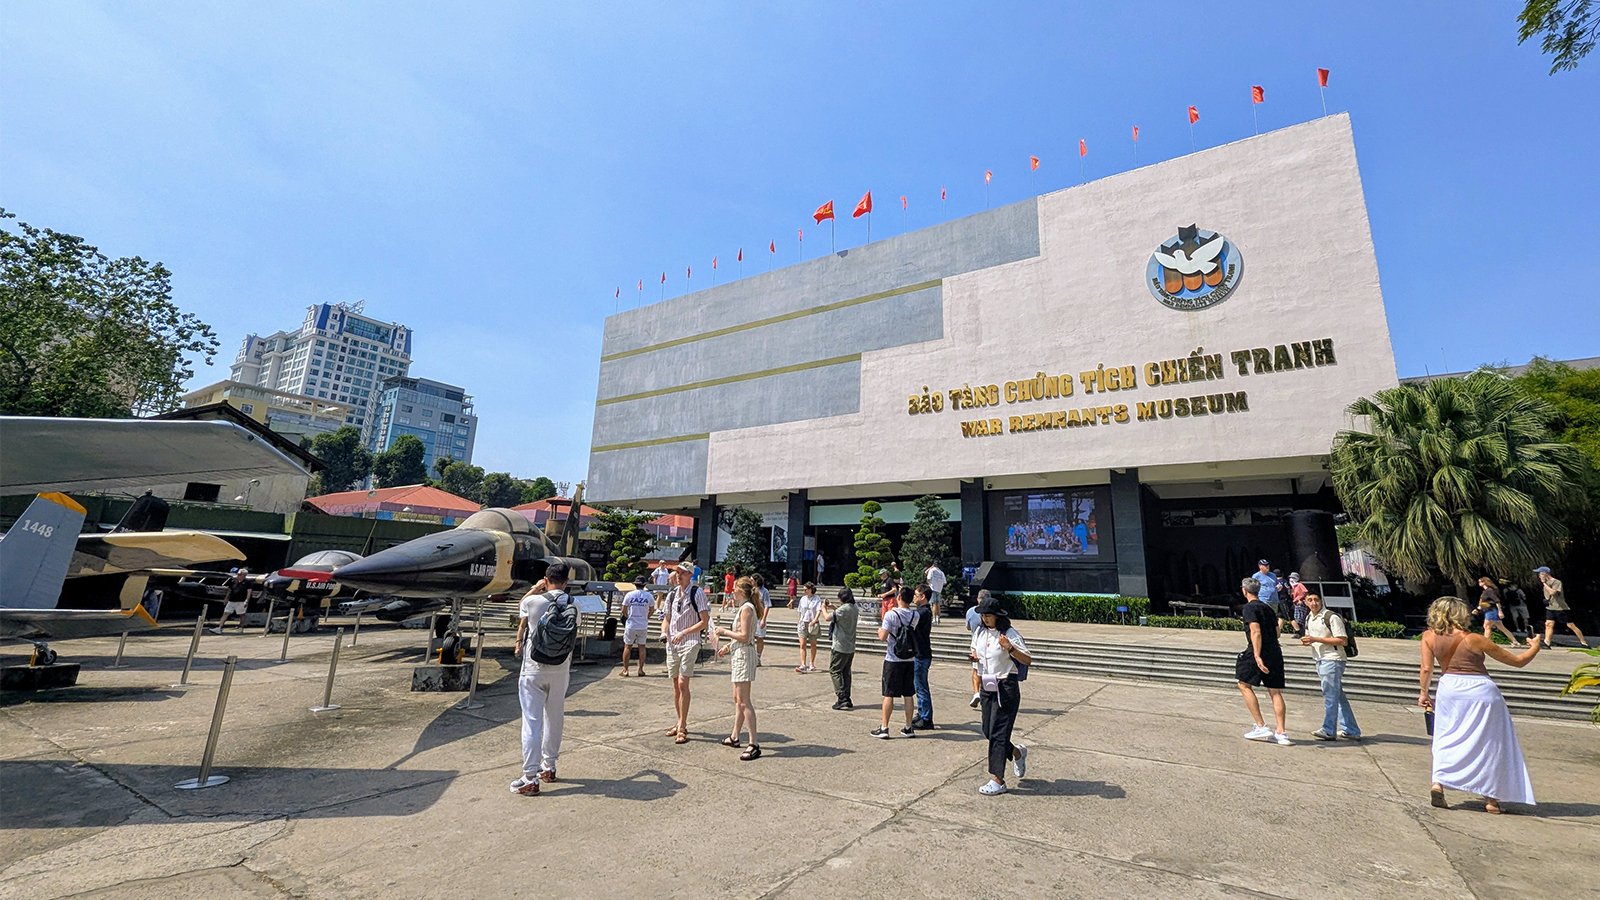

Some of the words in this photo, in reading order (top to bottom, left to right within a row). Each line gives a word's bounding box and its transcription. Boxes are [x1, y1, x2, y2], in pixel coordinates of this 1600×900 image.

[908, 385, 944, 415] BẢO
[949, 383, 999, 410] TÀNG
[1004, 372, 1075, 403] CHỨNG
[1080, 363, 1137, 394] TÍCH
[1144, 346, 1224, 387] CHIẾN
[1231, 338, 1337, 376] TRANH
[960, 418, 1003, 438] WAR
[1009, 404, 1130, 434] REMNANTS
[1136, 391, 1249, 422] MUSEUM
[21, 519, 54, 538] 1448
